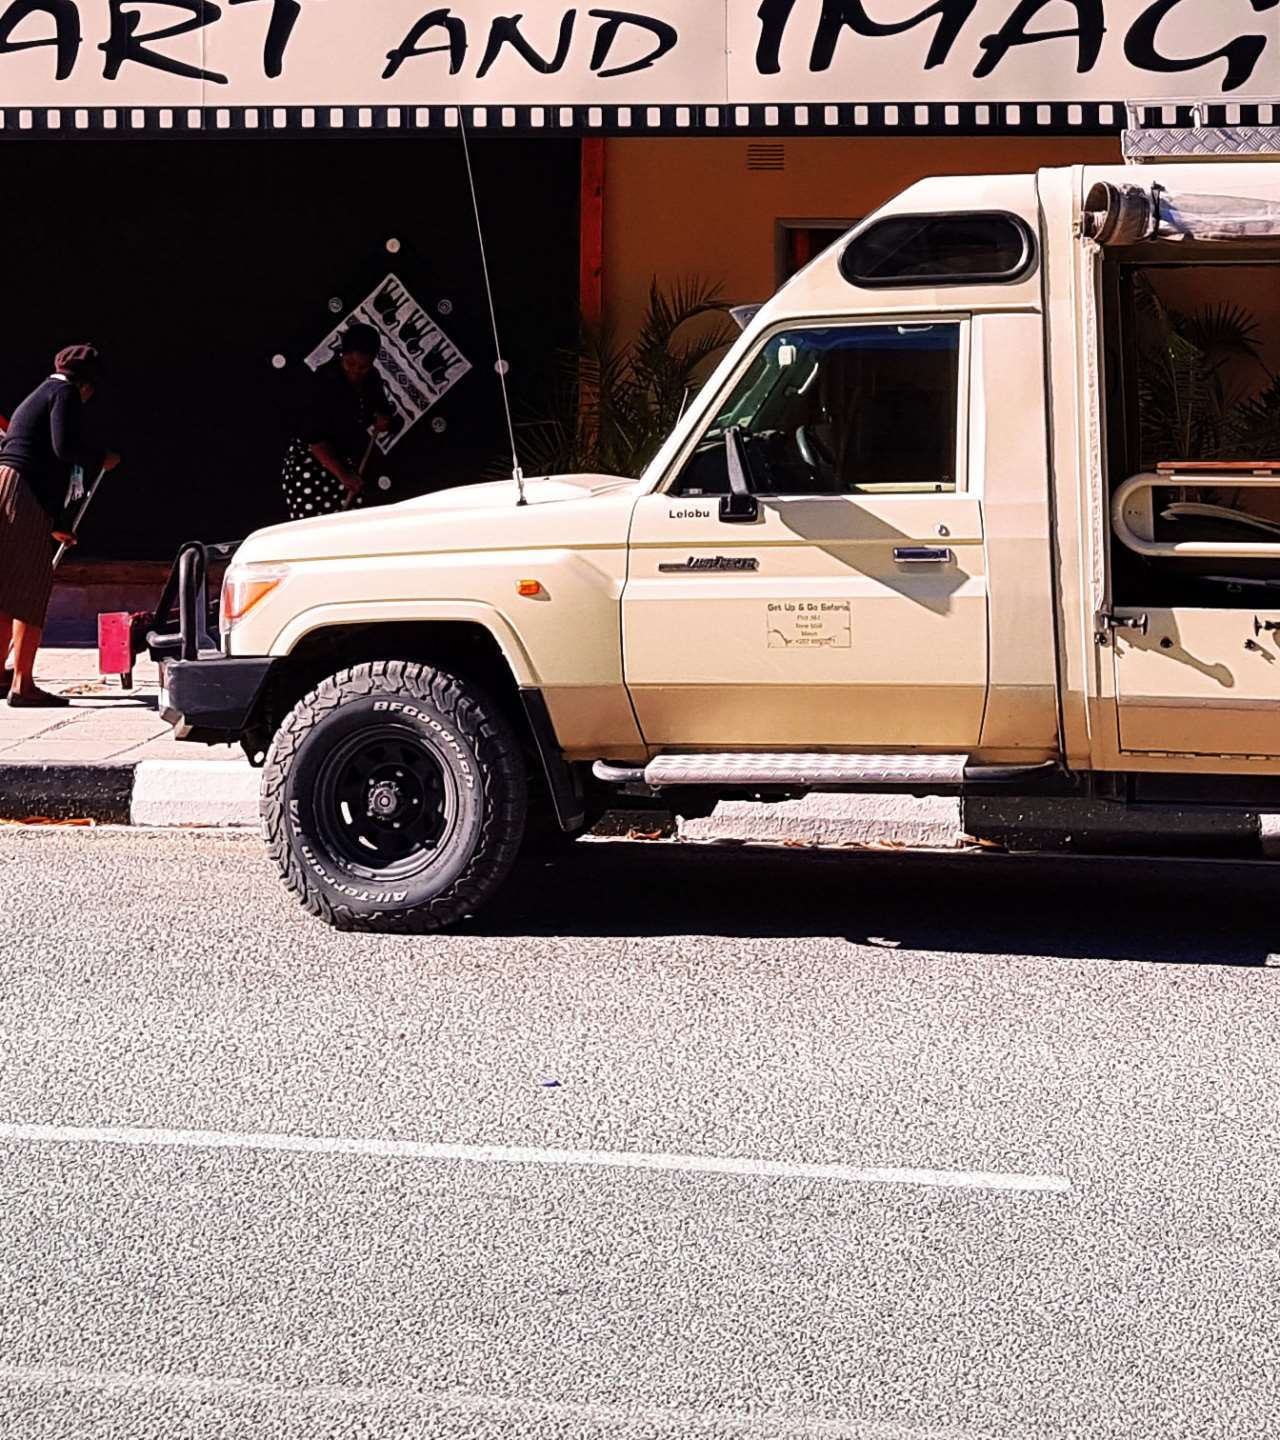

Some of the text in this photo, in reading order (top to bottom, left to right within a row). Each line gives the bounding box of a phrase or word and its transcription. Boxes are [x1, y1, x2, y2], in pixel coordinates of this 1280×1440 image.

[381, 8, 678, 80] AND
[669, 509, 710, 519] Lelobu
[373, 701, 474, 788] BFGoodrich
[301, 845, 408, 903] All-Terrain
